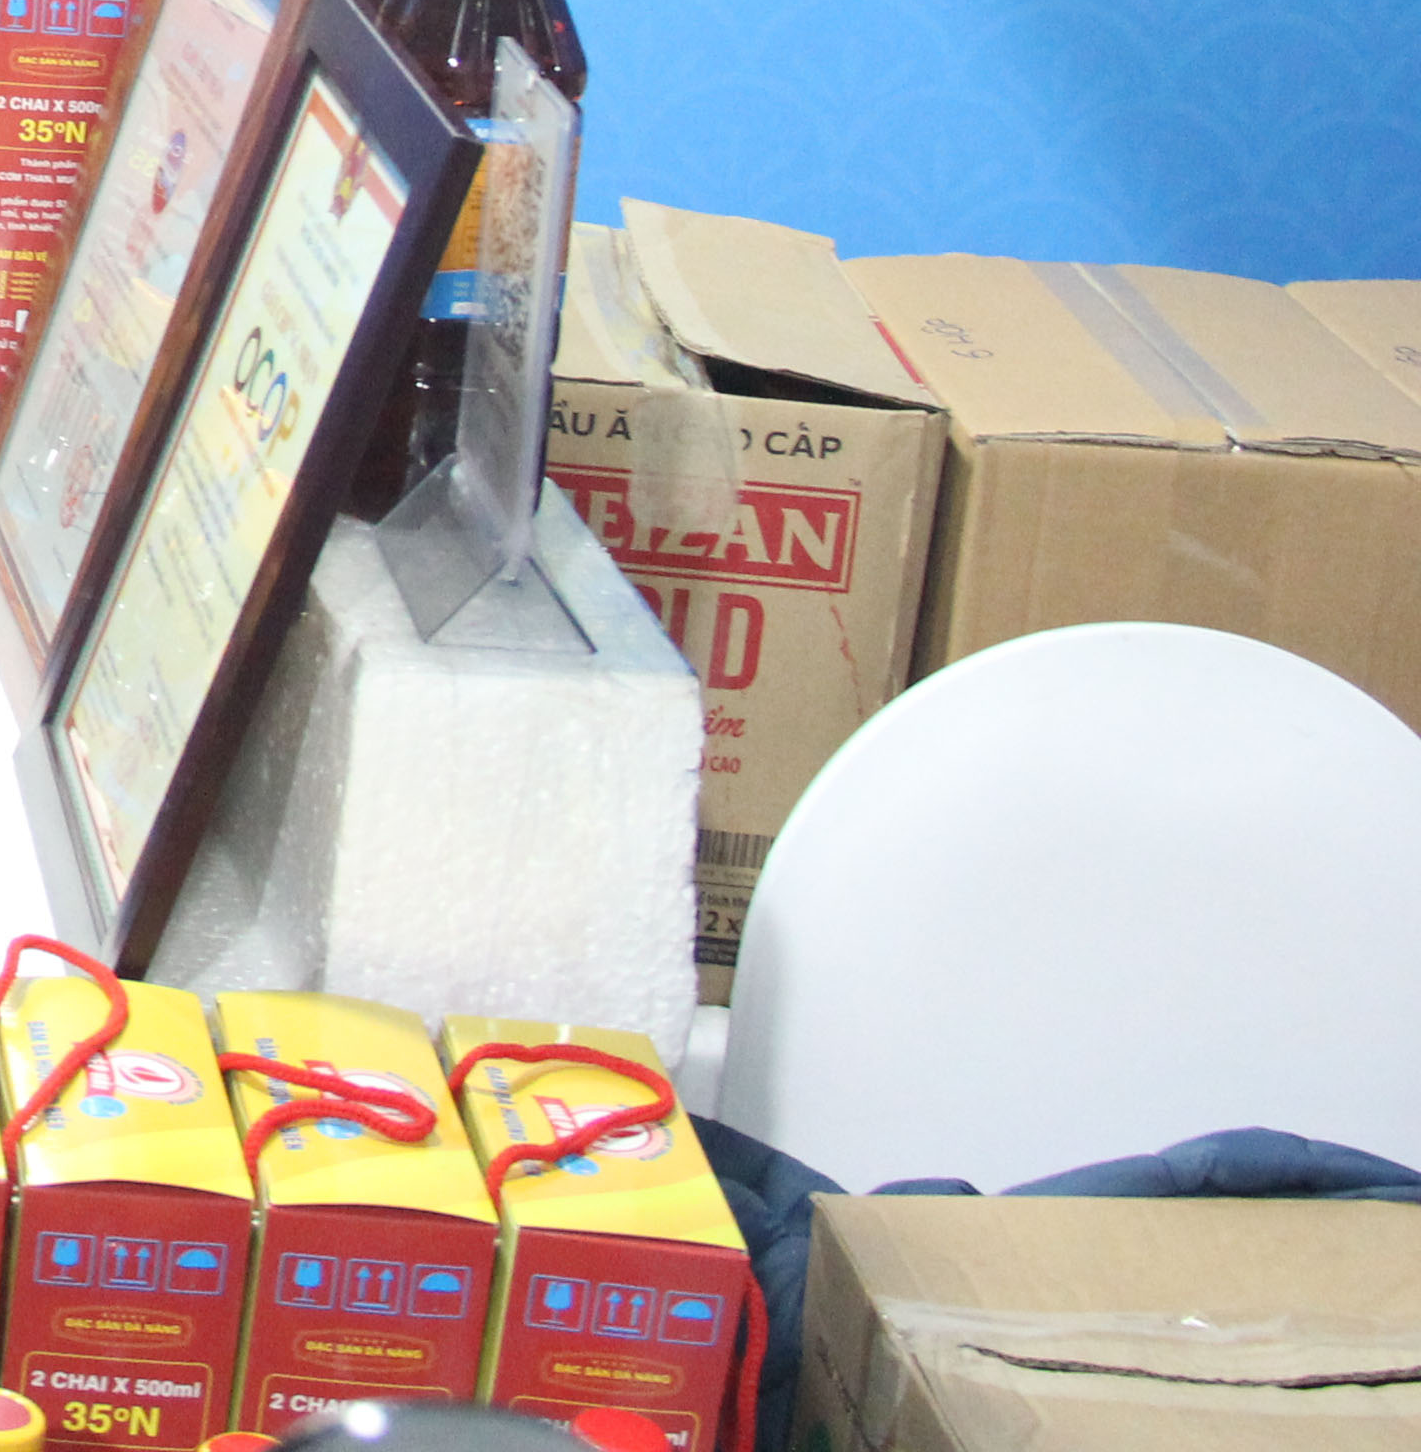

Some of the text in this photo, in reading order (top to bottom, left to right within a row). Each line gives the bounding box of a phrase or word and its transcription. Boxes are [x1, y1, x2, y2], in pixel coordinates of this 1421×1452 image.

[10, 96, 50, 112] CHAI
[53, 98, 65, 113] X
[547, 400, 596, 437] ẦU
[764, 421, 843, 460] CẤP
[30, 1370, 203, 1399] 2 CHAI X 500ml
[268, 1392, 286, 1410] 2
